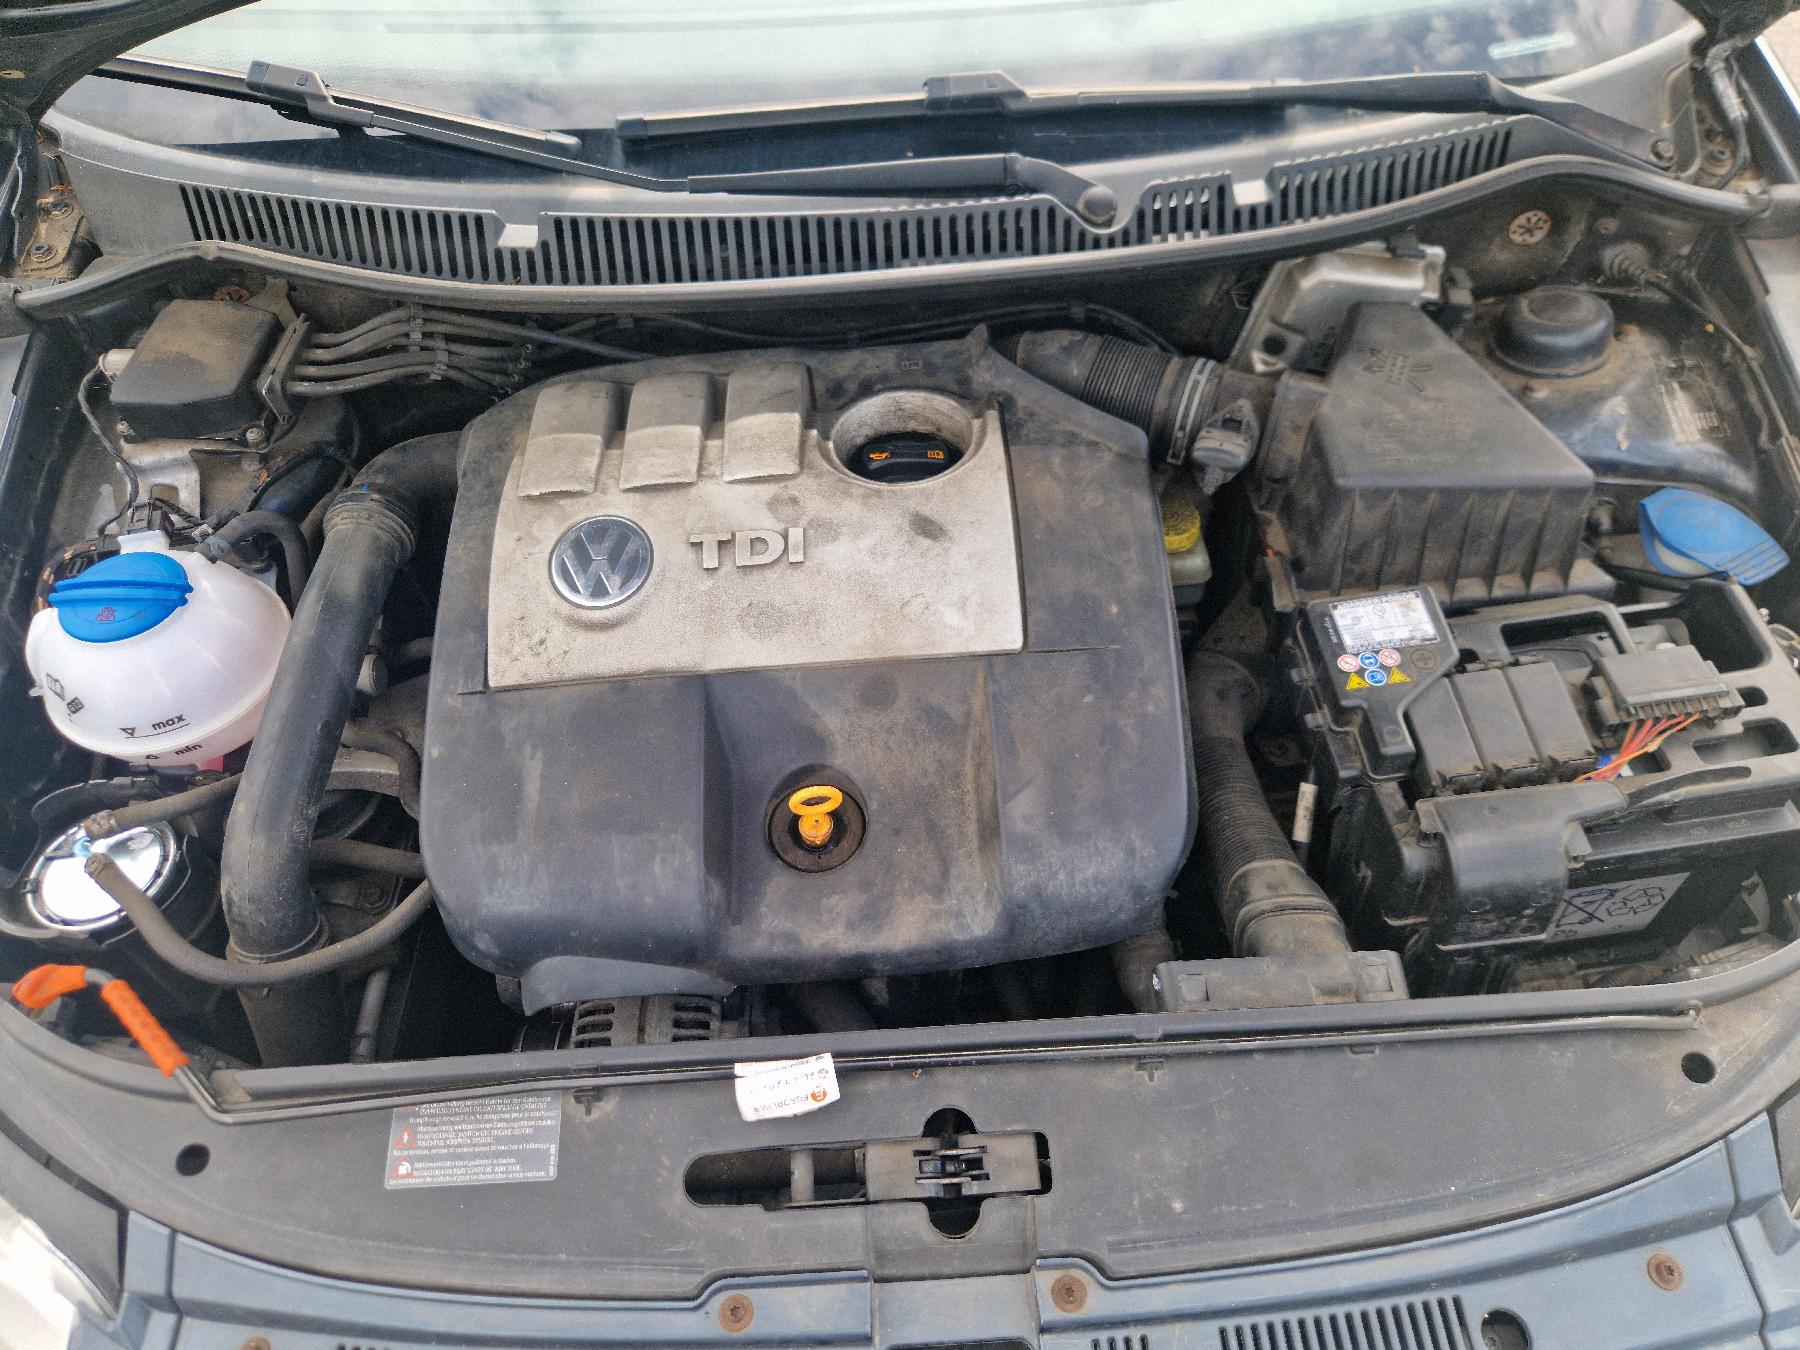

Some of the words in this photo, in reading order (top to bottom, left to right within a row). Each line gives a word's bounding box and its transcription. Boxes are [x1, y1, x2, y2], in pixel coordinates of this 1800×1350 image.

[690, 527, 804, 570] TDI
[152, 714, 186, 730] max
[174, 744, 202, 755] min
